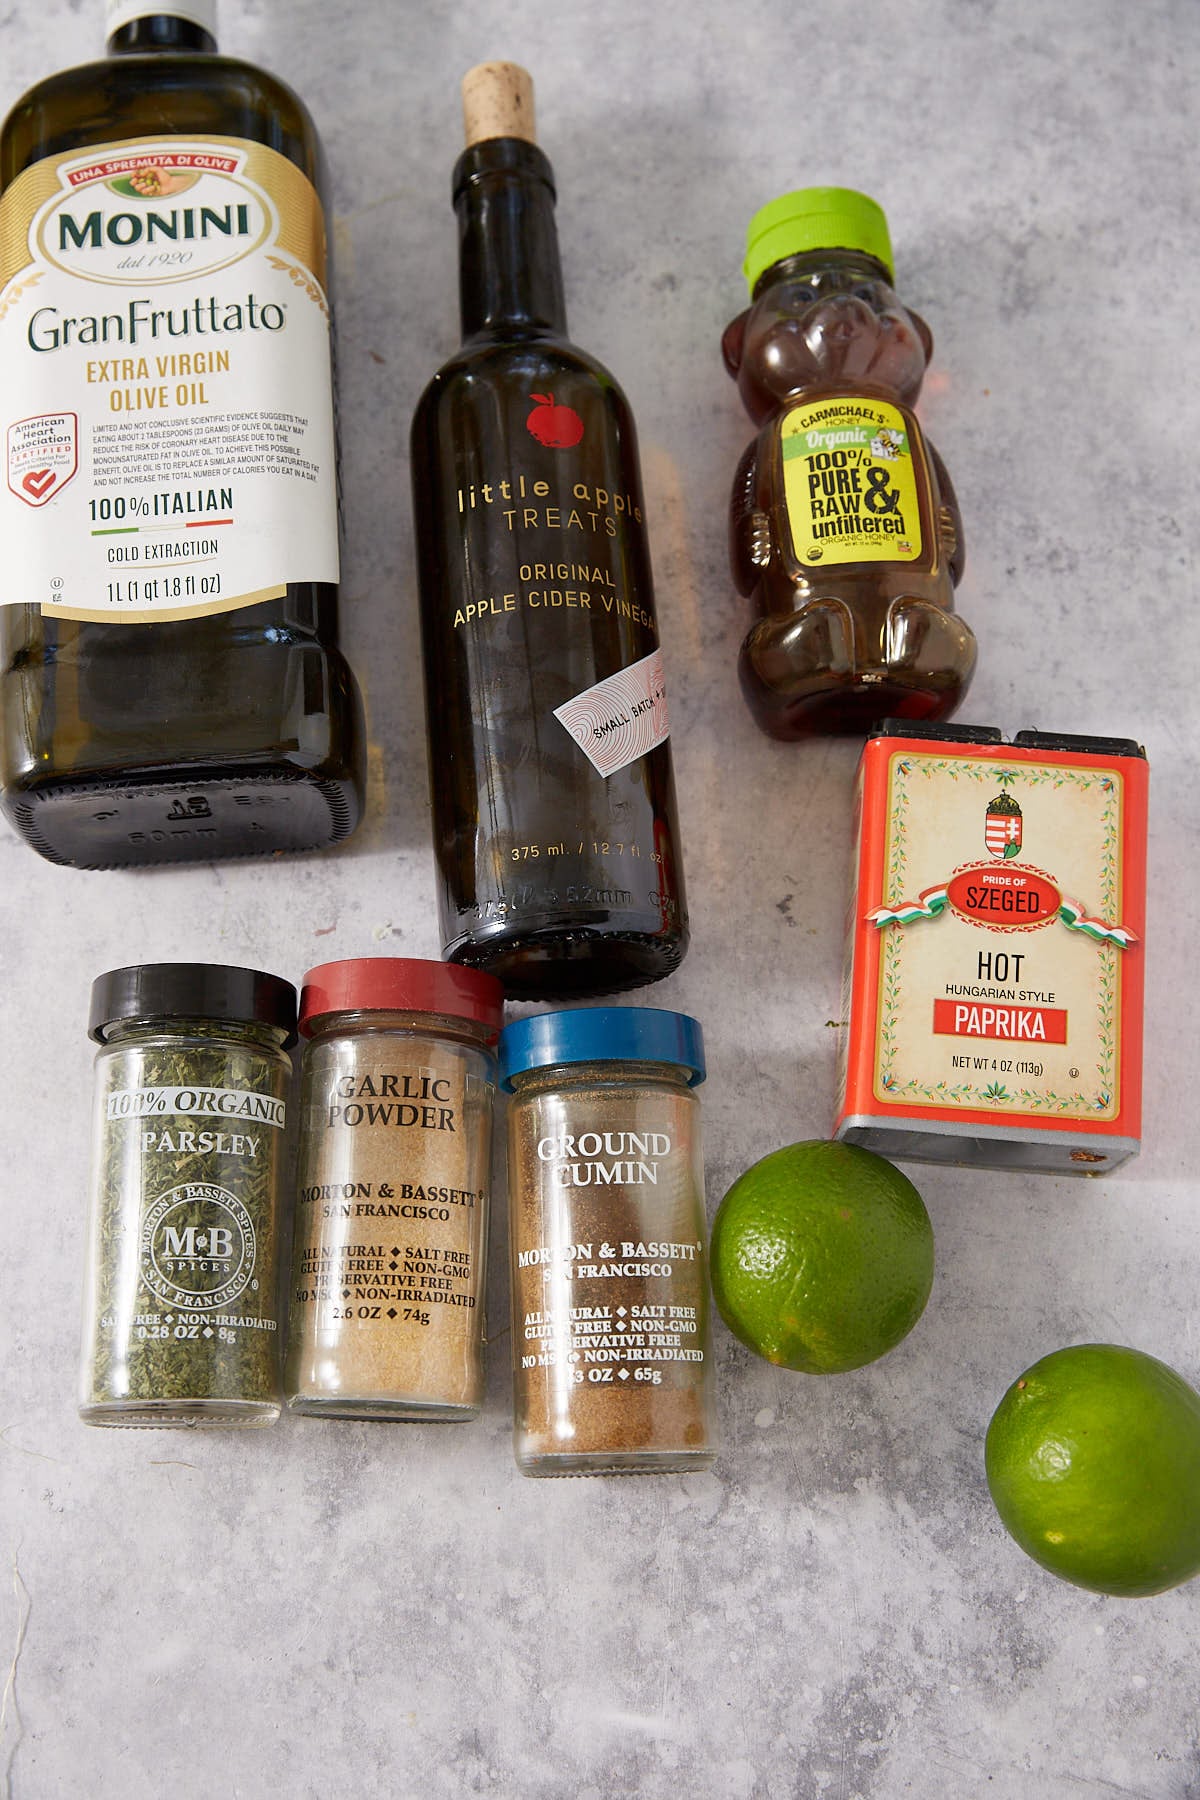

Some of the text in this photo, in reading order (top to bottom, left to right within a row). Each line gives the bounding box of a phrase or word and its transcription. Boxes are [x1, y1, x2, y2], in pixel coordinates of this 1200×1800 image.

[73, 156, 232, 182] UNA SPREMUTA DI OLIVE
[59, 204, 249, 250] MONINI
[116, 251, 193, 270] dal 1920
[27, 294, 285, 353] GranFruttato
[87, 350, 230, 383] EXTRA VIRGIN
[110, 383, 209, 412] OLIVE OIL
[15, 418, 65, 434] American
[800, 406, 886, 428] CARMICHAEL'S
[825, 416, 860, 427] HONEY
[12, 435, 71, 453] Association
[23, 427, 54, 440] Heart
[805, 426, 868, 450] Organic
[804, 449, 872, 473] 100%
[458, 476, 642, 524] little apple
[808, 466, 903, 516] PURE &
[88, 487, 234, 521] 100% ITALIAN
[810, 494, 860, 520] RAW
[502, 508, 618, 537] TREATS
[812, 514, 906, 540] unfiltered
[107, 538, 219, 563] COLD EXTRACTION
[820, 534, 862, 546] ORGANIC
[865, 533, 896, 542] HONEY
[128, 580, 140, 602] (1
[144, 579, 160, 602] qt
[164, 576, 181, 598] 1.8
[184, 574, 196, 596] fl
[200, 573, 222, 595] oz)
[519, 563, 617, 588] ORIGINAL
[453, 590, 592, 628] APPLE CIDER
[593, 697, 656, 739] SMALL BATCH
[510, 845, 540, 862] 375
[982, 876, 1027, 886] PRIDE OF
[966, 886, 1039, 914] SZEGED
[978, 951, 1025, 983] HOT
[946, 984, 1056, 1003] HUNGARIAN STYLE
[955, 1005, 1046, 1040] PAPRIKA
[952, 1055, 1044, 1076] NET WT 4 OZ (113g)
[338, 1074, 452, 1102] GARLIC
[110, 1090, 286, 1124] 100% ORGANIC
[327, 1103, 456, 1132] POWDER
[141, 1130, 260, 1158] PARSLEY
[537, 1132, 671, 1161] GROUND
[554, 1161, 660, 1188] CUMIN
[302, 1183, 372, 1204] MORTON
[378, 1183, 395, 1199] &
[143, 1186, 254, 1258] MORTON & BASSETT SPICES
[323, 1204, 450, 1222] SAN FRANCISCO
[166, 1261, 230, 1272] SPICES
[302, 1248, 318, 1260] ALL
[406, 1247, 441, 1260] SALT
[444, 1252, 470, 1265] FREE
[348, 1259, 384, 1272] FREE
[518, 1243, 594, 1268] MORON
[598, 1242, 616, 1259] &
[315, 1274, 453, 1290] PRSERVATIVE FREE
[544, 1263, 672, 1282] SN FRANCISCO
[146, 1269, 247, 1307] SAN FRANCISCO
[355, 1288, 476, 1308] NON-IRRADIATED
[178, 1314, 277, 1331] NON-IRRADIATED
[333, 1306, 431, 1326] 2.6 OZ 74g
[524, 1305, 696, 1326] ALL NURAL SALT FREE
[575, 1320, 697, 1334] FREE NON-GMO
[138, 1326, 238, 1344] 0.28 OZ 8g
[648, 1334, 681, 1347] FREE
[522, 1349, 704, 1369] NO NON-IRRADIATED
[588, 1368, 614, 1382] OZ
[634, 1367, 662, 1385] 65g
